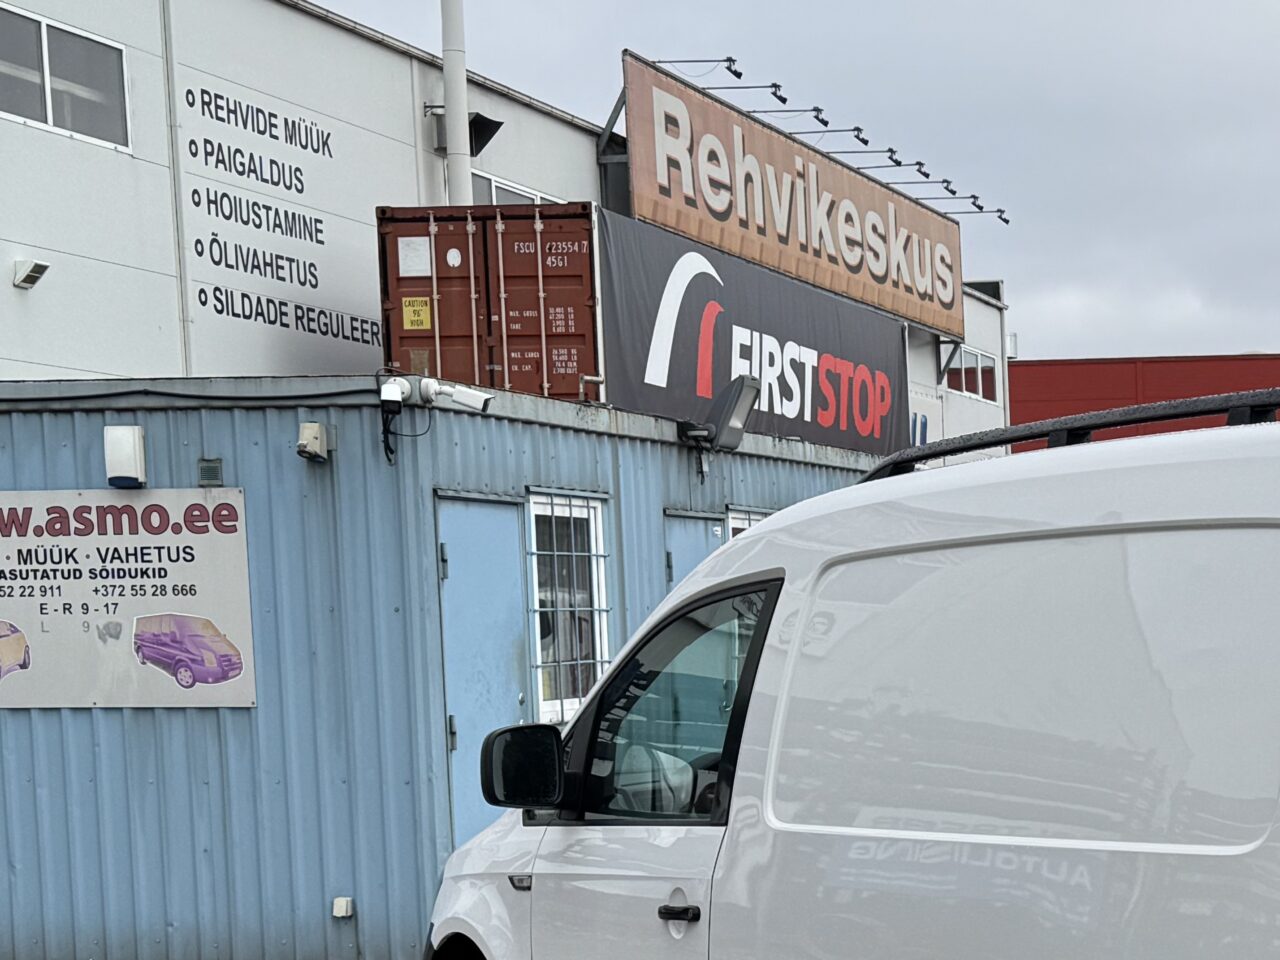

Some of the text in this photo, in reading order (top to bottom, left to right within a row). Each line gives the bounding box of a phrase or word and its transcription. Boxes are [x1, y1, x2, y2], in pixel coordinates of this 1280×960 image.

[200, 87, 333, 159] REHVIDE MÜÜK
[203, 137, 305, 194] PAIGALDUS
[206, 187, 325, 246] HOIUSTAMINE
[652, 85, 956, 310] Rehvikeskus
[208, 231, 319, 289] ÕLIVAHETUS
[514, 242, 536, 254] FSCU
[213, 286, 382, 348] SILDADE REGULEER
[17, 545, 196, 566] MÜÜK VAHETUS
[88, 565, 168, 580] SÕIDUKID
[19, 585, 35, 598] 22
[39, 585, 62, 598] 911
[40, 602, 49, 615] E
[62, 602, 73, 615] R
[81, 602, 90, 615] 9
[103, 602, 119, 615] 17
[92, 583, 197, 597] +372 55 28 666
